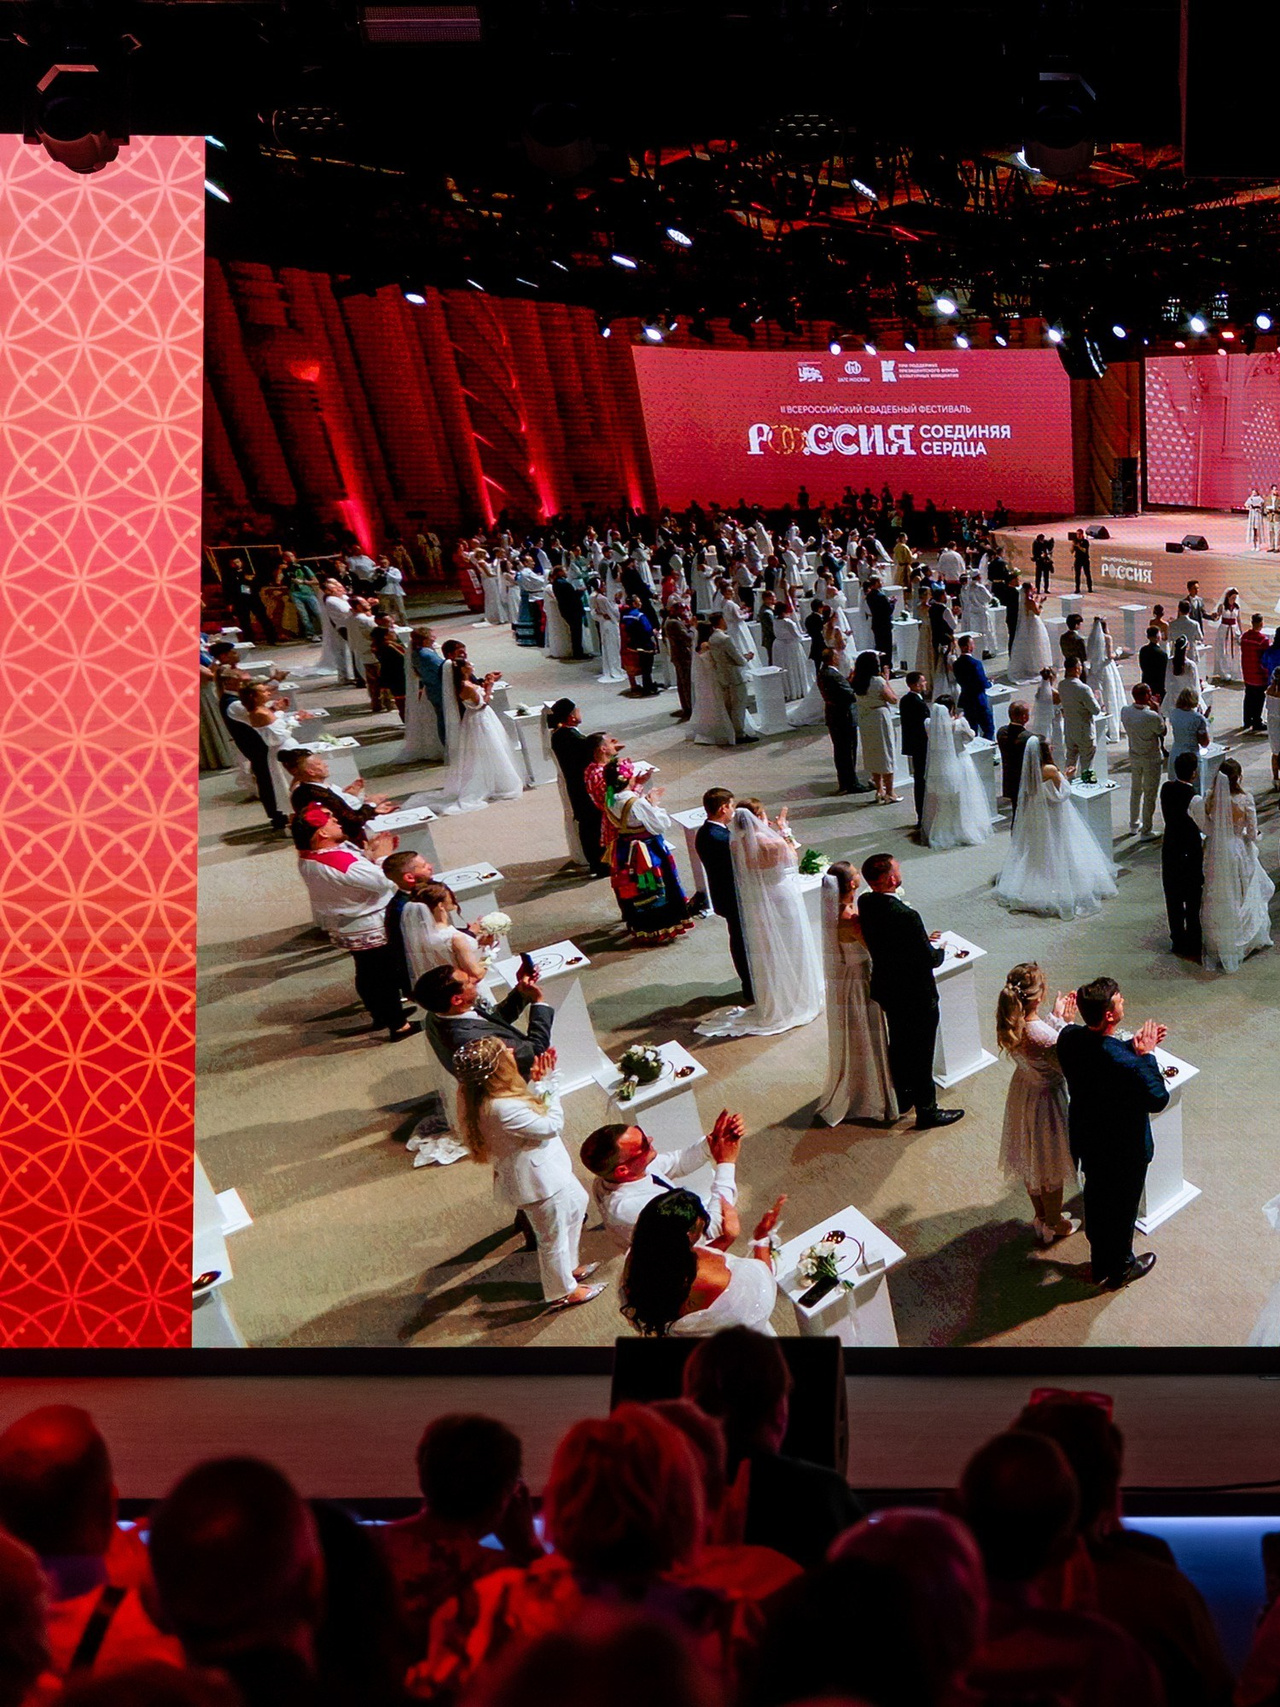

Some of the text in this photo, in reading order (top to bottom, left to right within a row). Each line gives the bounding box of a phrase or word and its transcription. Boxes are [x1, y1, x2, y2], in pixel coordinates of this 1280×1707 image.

[786, 403, 862, 414] ВСЕРОССИЙСКИЙ
[864, 403, 918, 415] СВАДЕБНЫЙ
[918, 404, 973, 414] ФЕСТИВАЛЬ
[919, 424, 1012, 441] СОЕДИНЯЯ
[921, 441, 988, 458] СЕРДЦА
[1101, 563, 1153, 583] РОССИЯ
